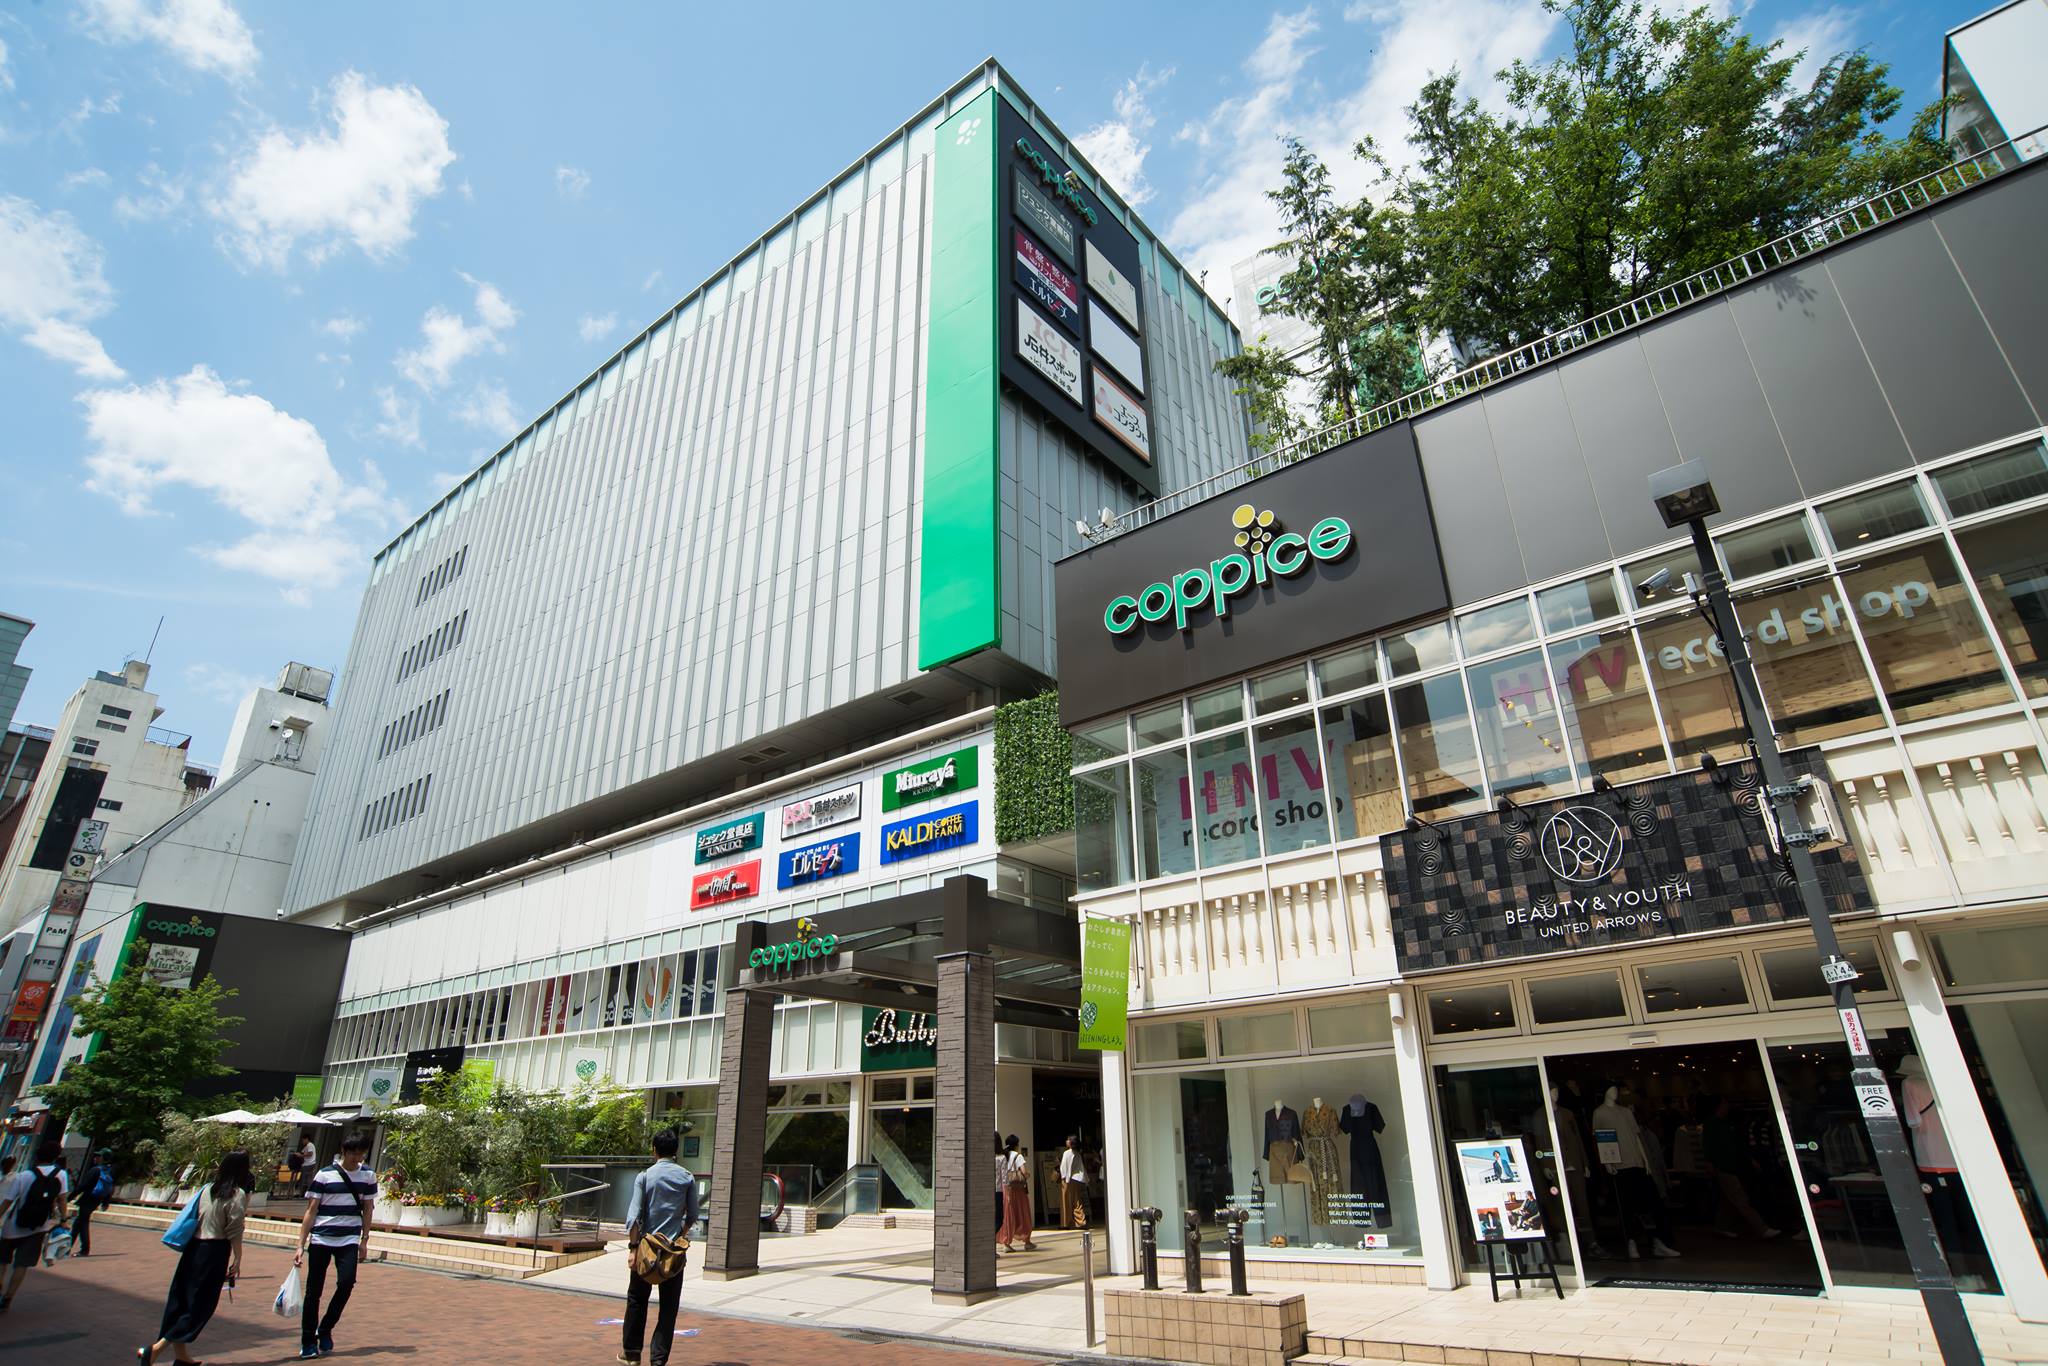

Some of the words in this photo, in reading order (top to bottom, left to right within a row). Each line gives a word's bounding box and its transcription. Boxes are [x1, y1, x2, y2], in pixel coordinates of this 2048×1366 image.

[1017, 137, 1098, 224] coppice
[1104, 508, 1352, 635] coppice
[1801, 581, 1929, 634] shop
[896, 757, 957, 793] Miuraya
[1179, 739, 1334, 820] HMV
[886, 819, 935, 851] KALDI
[934, 822, 962, 838] FARM
[935, 813, 962, 828] COFFEE
[147, 919, 216, 937] coppice
[1540, 922, 1589, 937] UNITED
[1595, 911, 1662, 930] ARROWS
[749, 926, 839, 972] coppice
[1861, 1087, 1884, 1095] FREE
